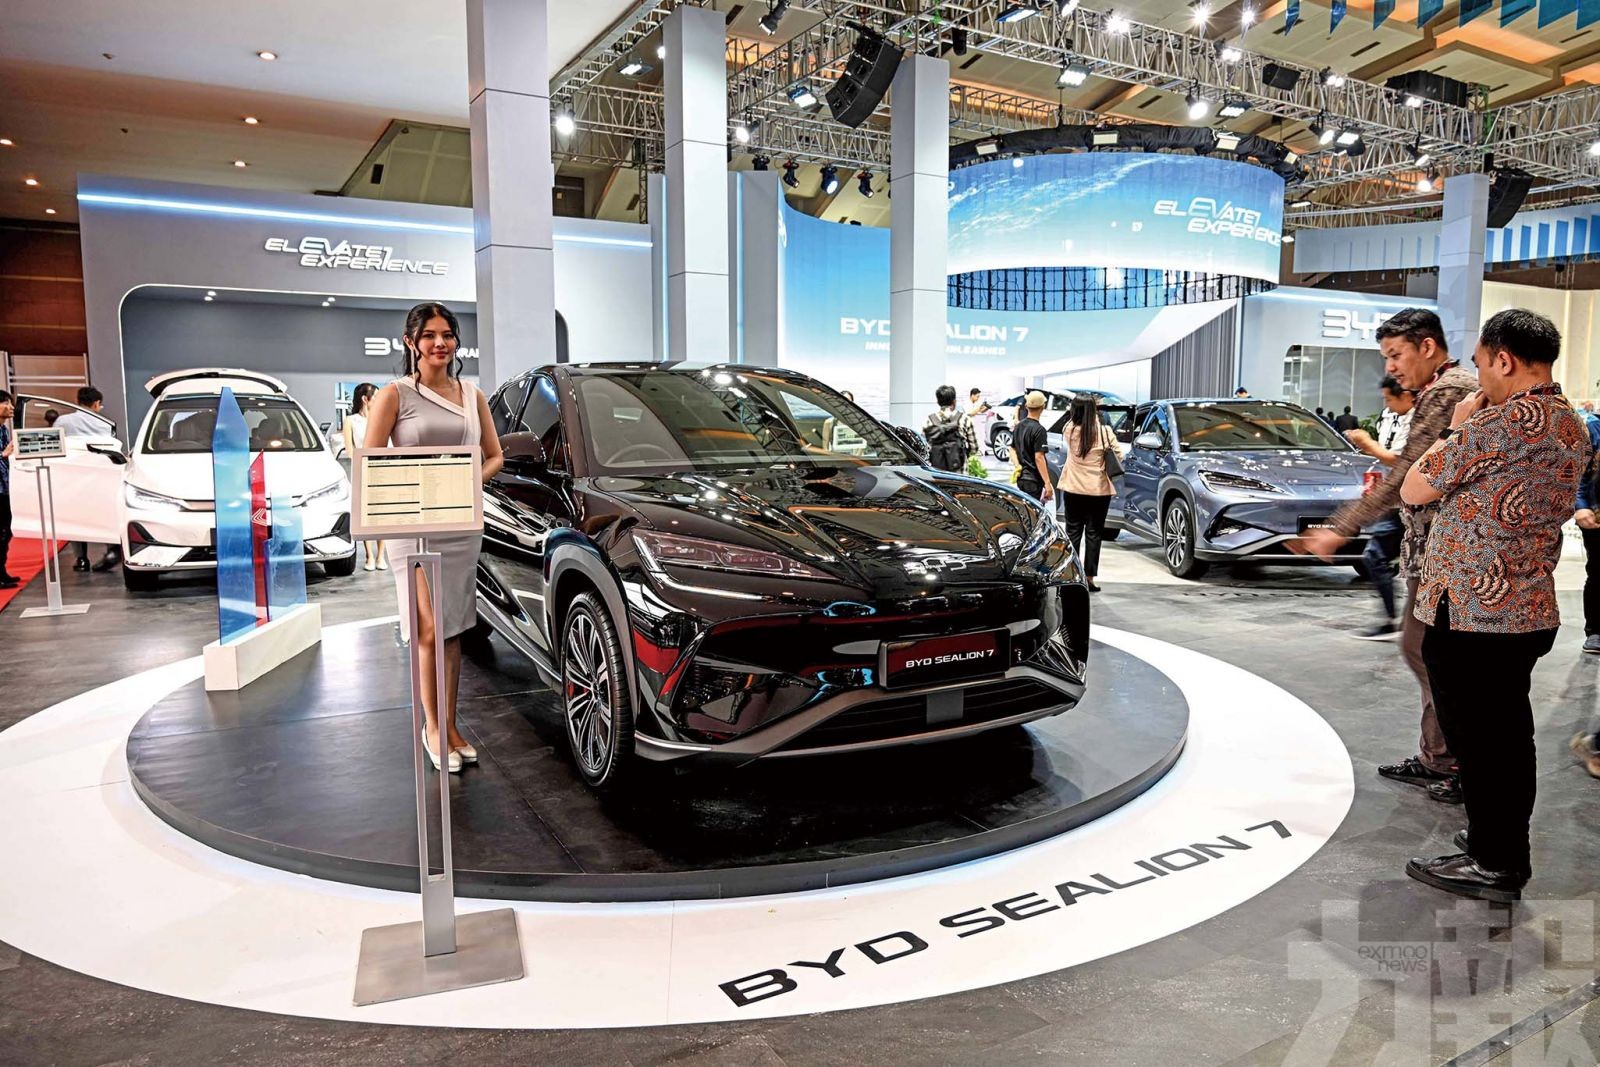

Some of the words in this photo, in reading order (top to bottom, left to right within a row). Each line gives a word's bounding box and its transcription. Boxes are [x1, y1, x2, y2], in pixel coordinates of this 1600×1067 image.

[1012, 326, 1030, 343] 7
[905, 657, 932, 668] BYD
[934, 650, 984, 664] SEALION
[986, 649, 995, 657] 7
[718, 930, 930, 1008] BYD
[939, 834, 1252, 939] SEALION
[1245, 819, 1293, 839] 7
